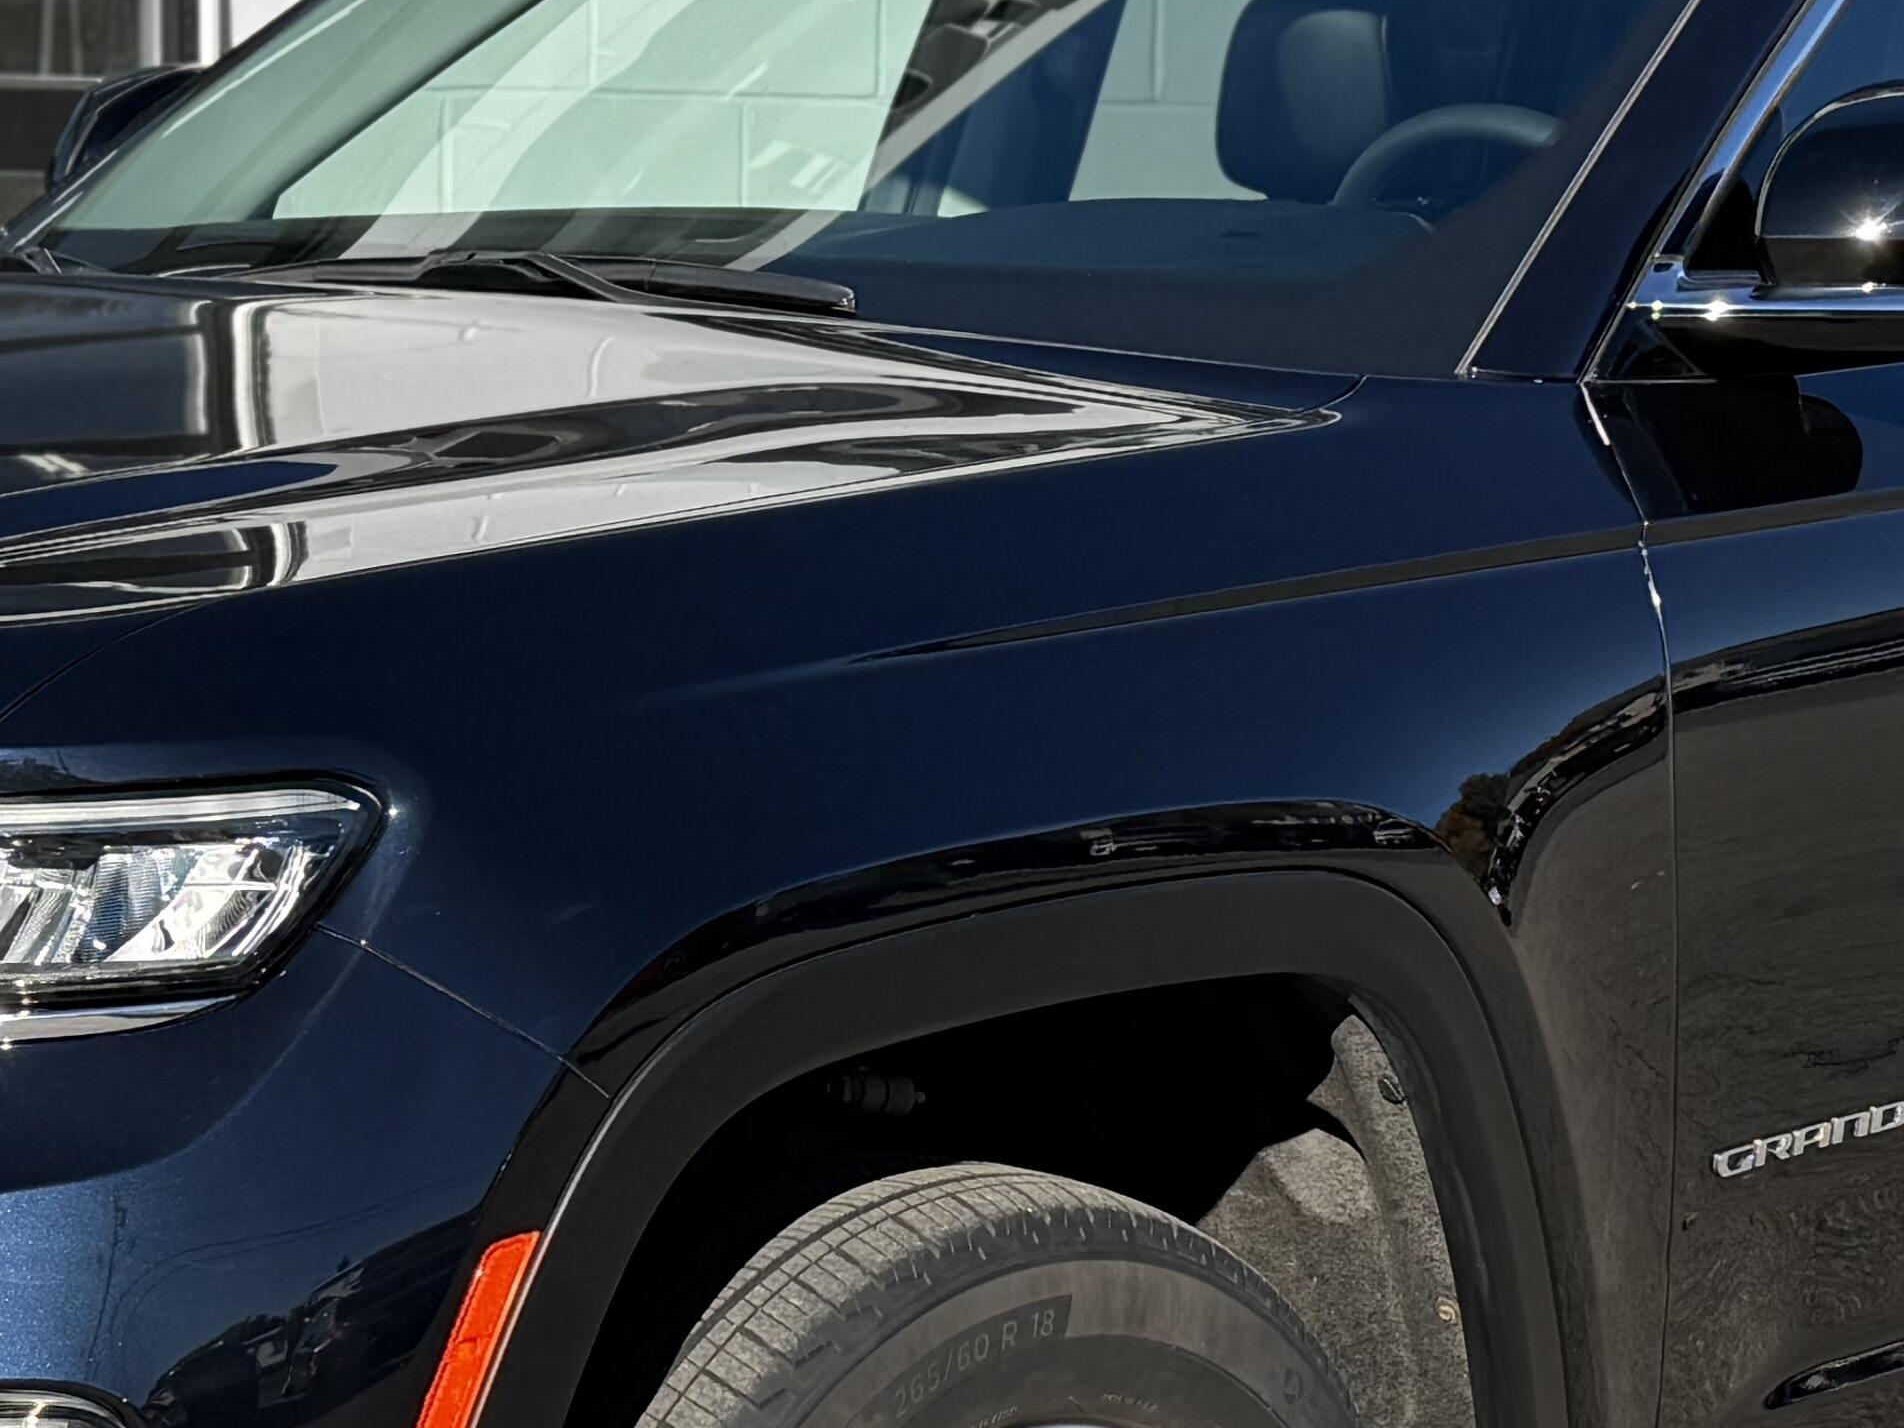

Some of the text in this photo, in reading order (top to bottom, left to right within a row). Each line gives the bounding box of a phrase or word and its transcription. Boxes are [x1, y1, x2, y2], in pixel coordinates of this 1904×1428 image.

[895, 1310, 1055, 1418] 265/60 R 18
